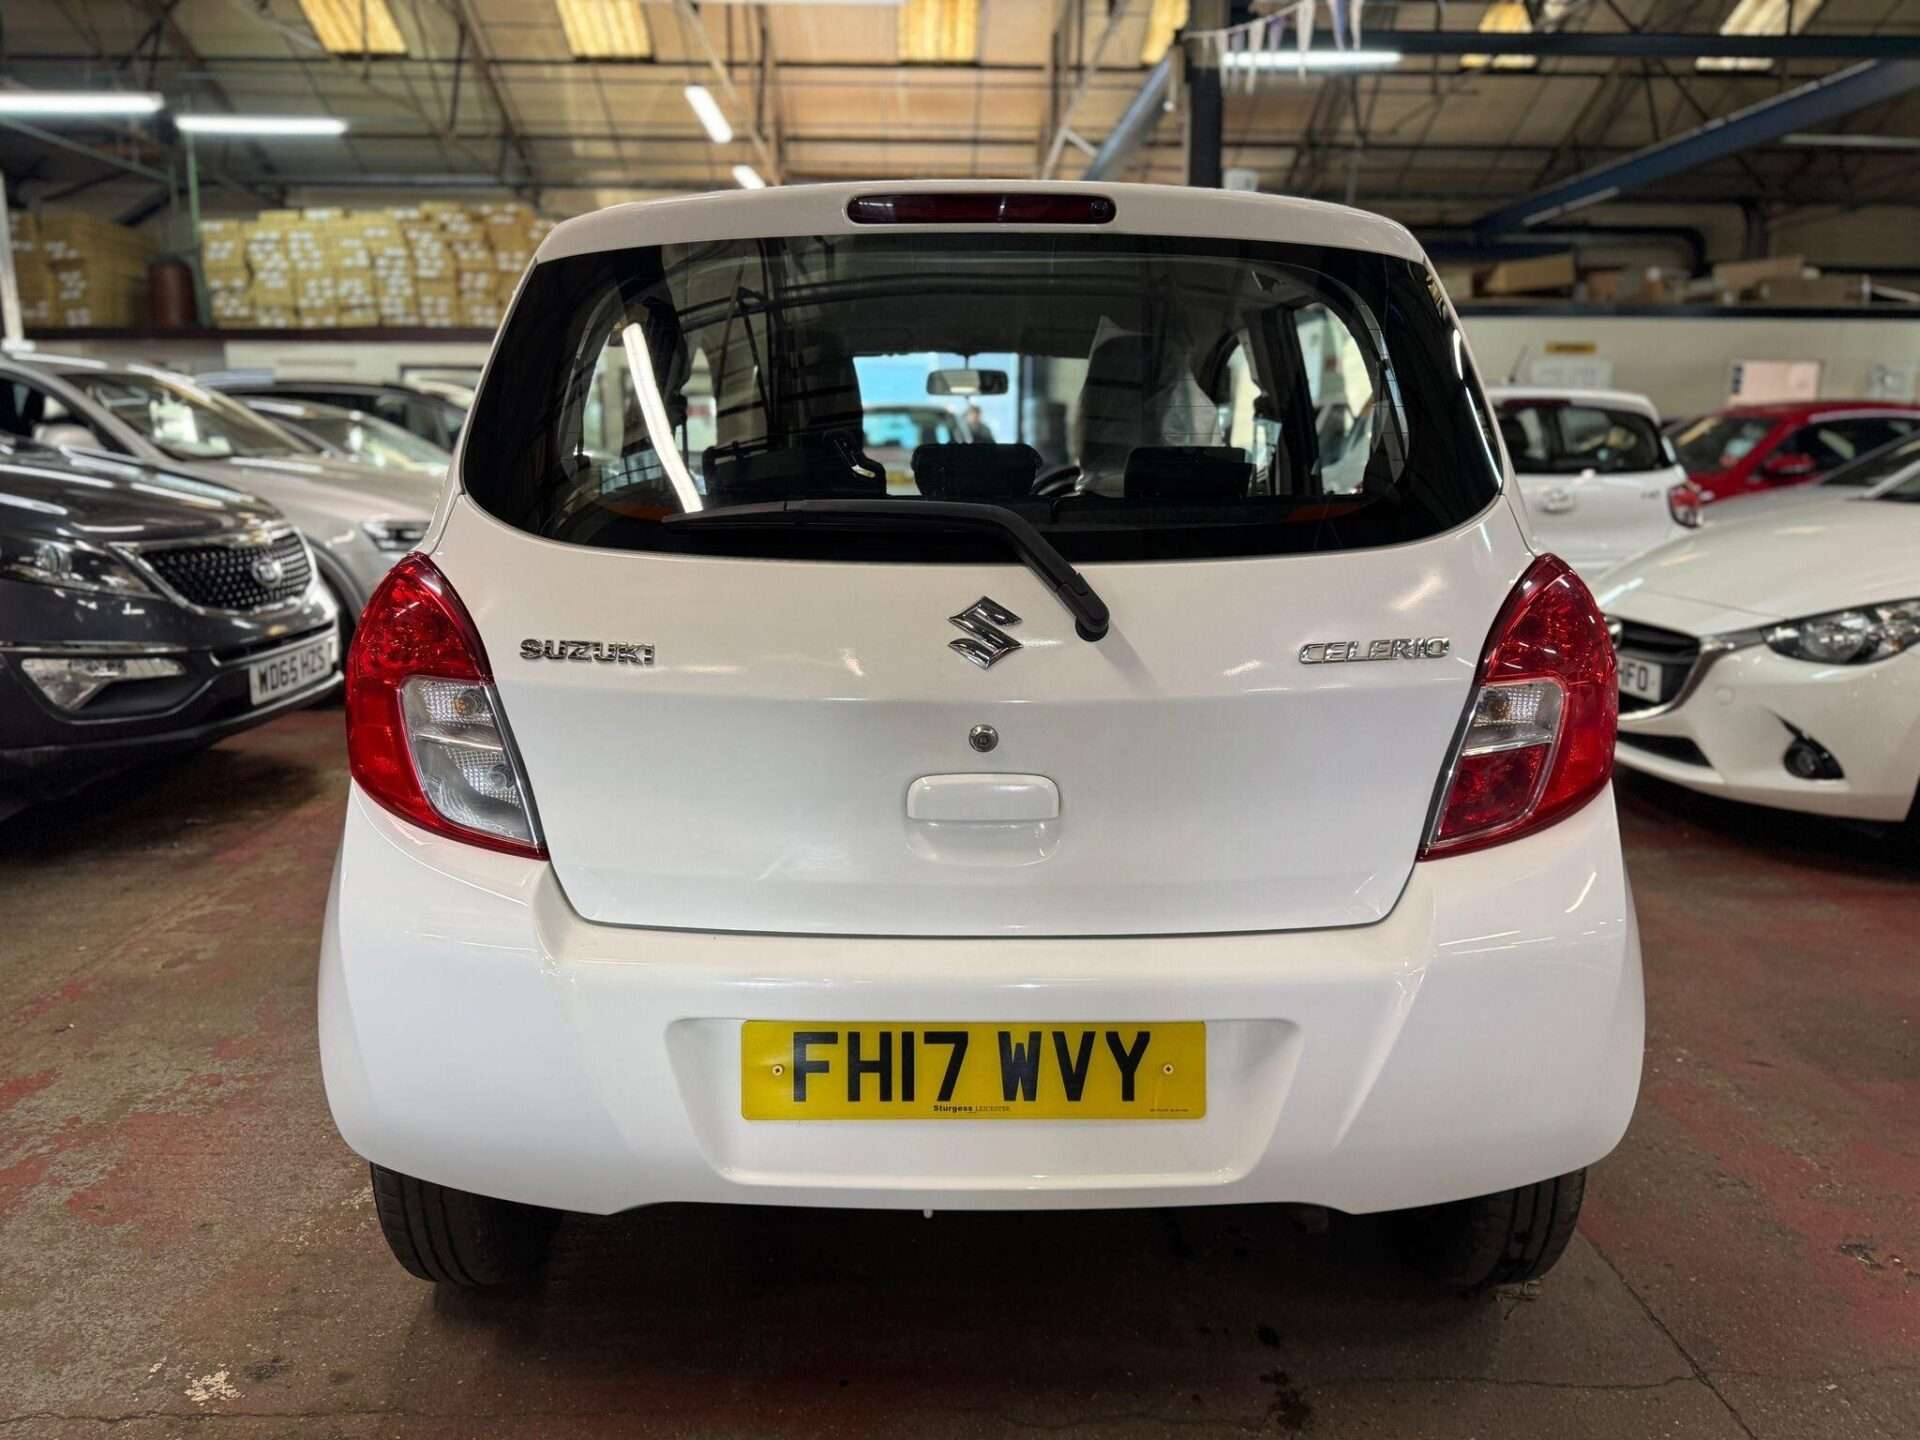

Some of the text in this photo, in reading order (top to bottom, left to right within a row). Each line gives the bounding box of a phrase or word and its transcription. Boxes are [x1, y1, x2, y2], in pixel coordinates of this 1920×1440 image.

[520, 638, 655, 666] SUZUKI
[1299, 636, 1449, 664] CELERIO
[793, 1031, 1151, 1102] FH17 WVY
[932, 1104, 973, 1113] Sturgess
